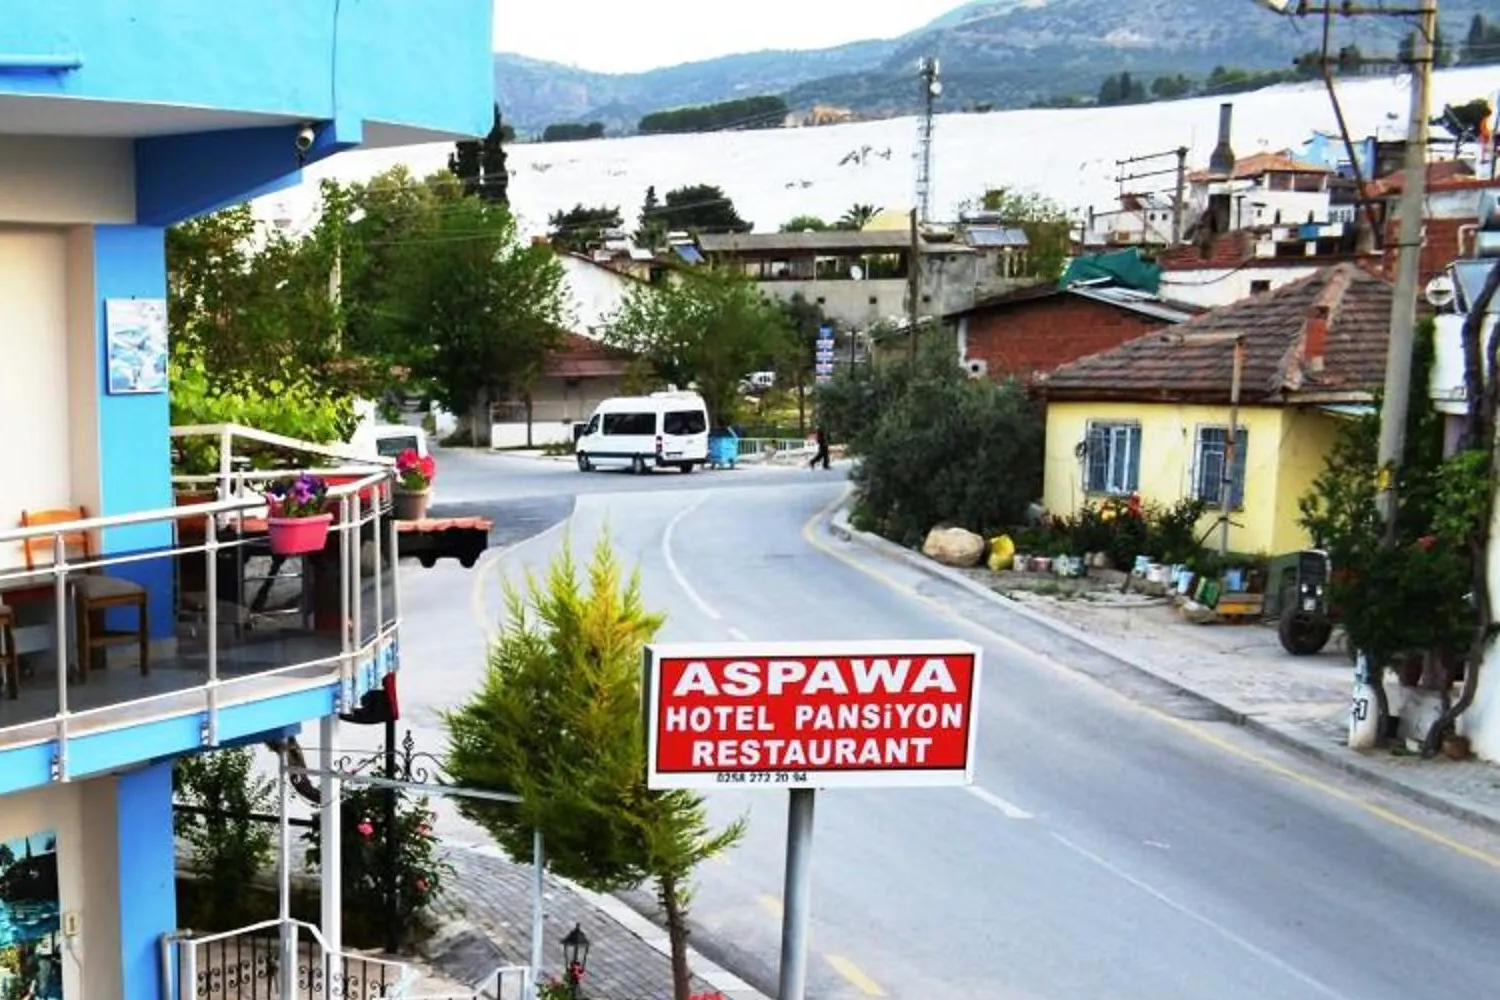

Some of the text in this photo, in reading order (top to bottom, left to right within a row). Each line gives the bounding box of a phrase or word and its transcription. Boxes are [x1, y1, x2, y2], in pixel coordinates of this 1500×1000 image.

[672, 659, 957, 697] ASPAWA
[666, 705, 775, 732] HOTEL
[692, 738, 933, 767] RESTAURANT
[716, 772, 745, 783] 0258
[749, 772, 771, 783] 272
[775, 772, 790, 783] 20
